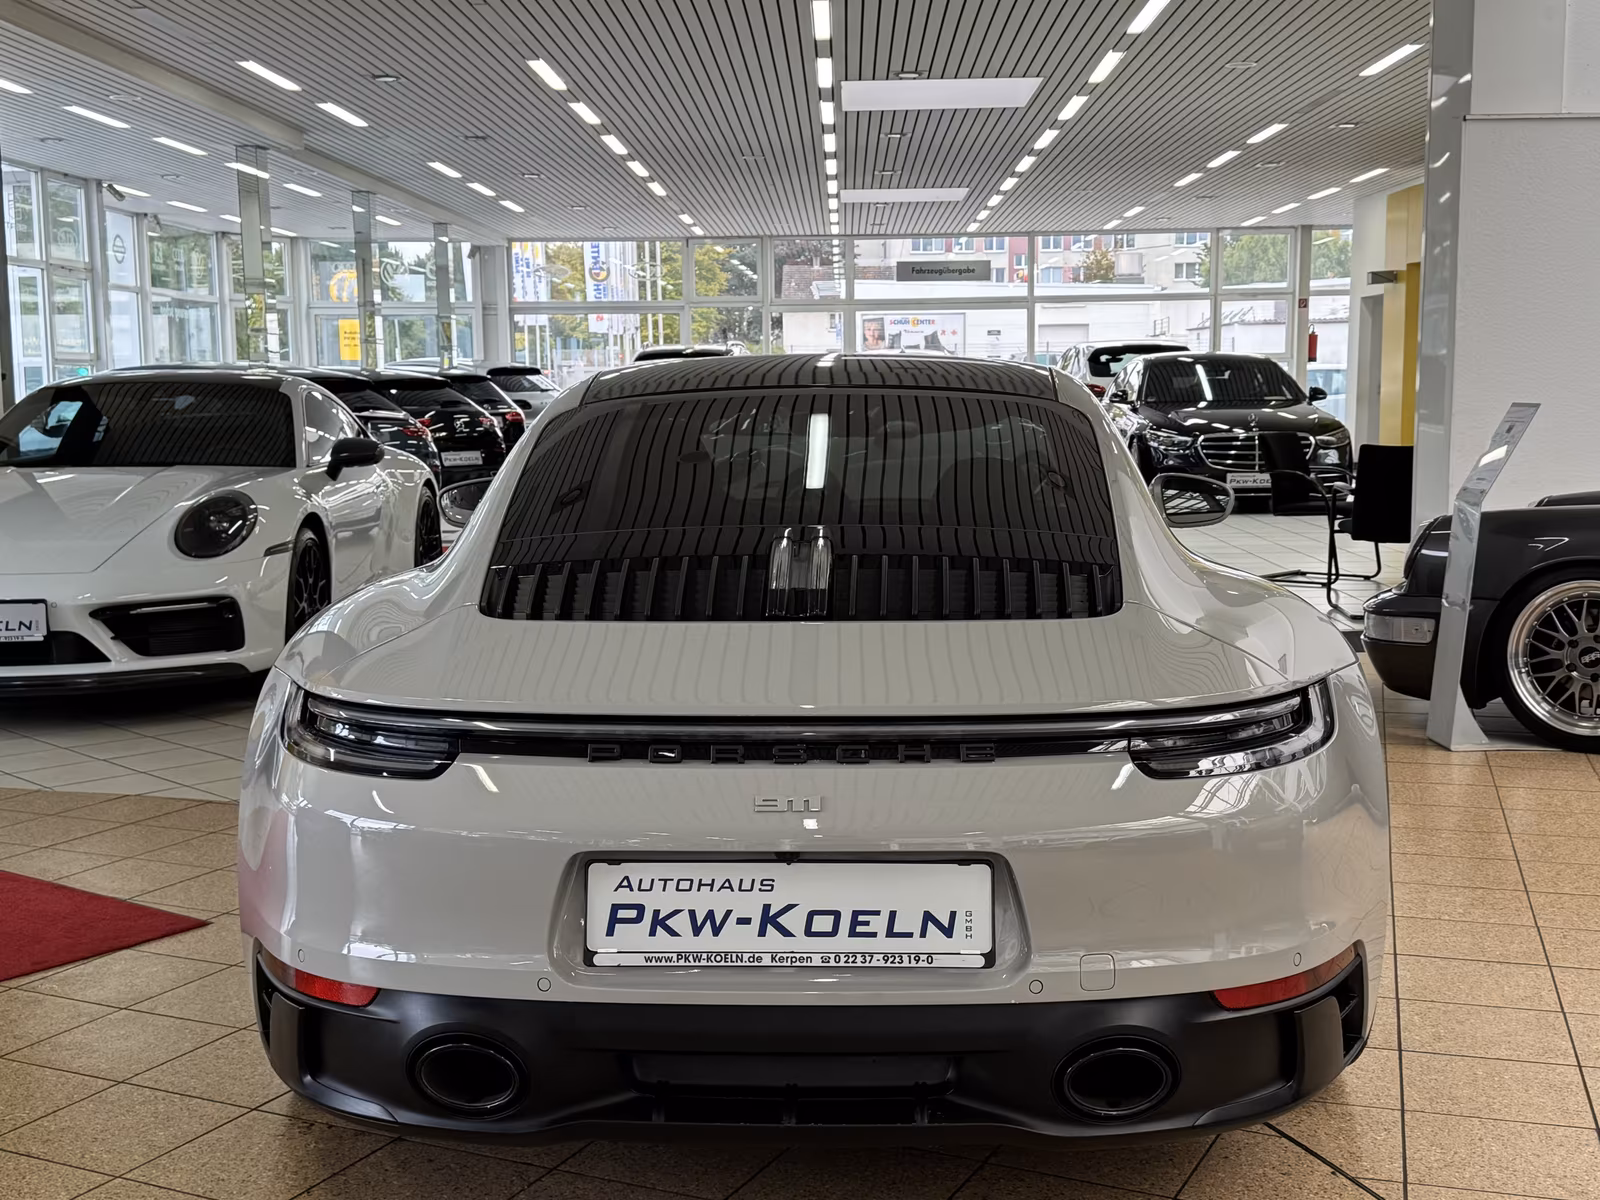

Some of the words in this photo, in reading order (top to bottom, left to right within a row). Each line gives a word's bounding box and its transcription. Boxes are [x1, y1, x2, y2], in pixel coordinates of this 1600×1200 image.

[911, 266, 976, 275] Fahrzeugübergabe
[588, 743, 996, 764] PORSCHE
[754, 795, 822, 813] 911
[613, 875, 776, 893] AUTOHAUS
[605, 903, 958, 939] PKW-KOELN
[644, 953, 763, 964] www.PKW-KOELN.de
[770, 954, 813, 966] Kerpen
